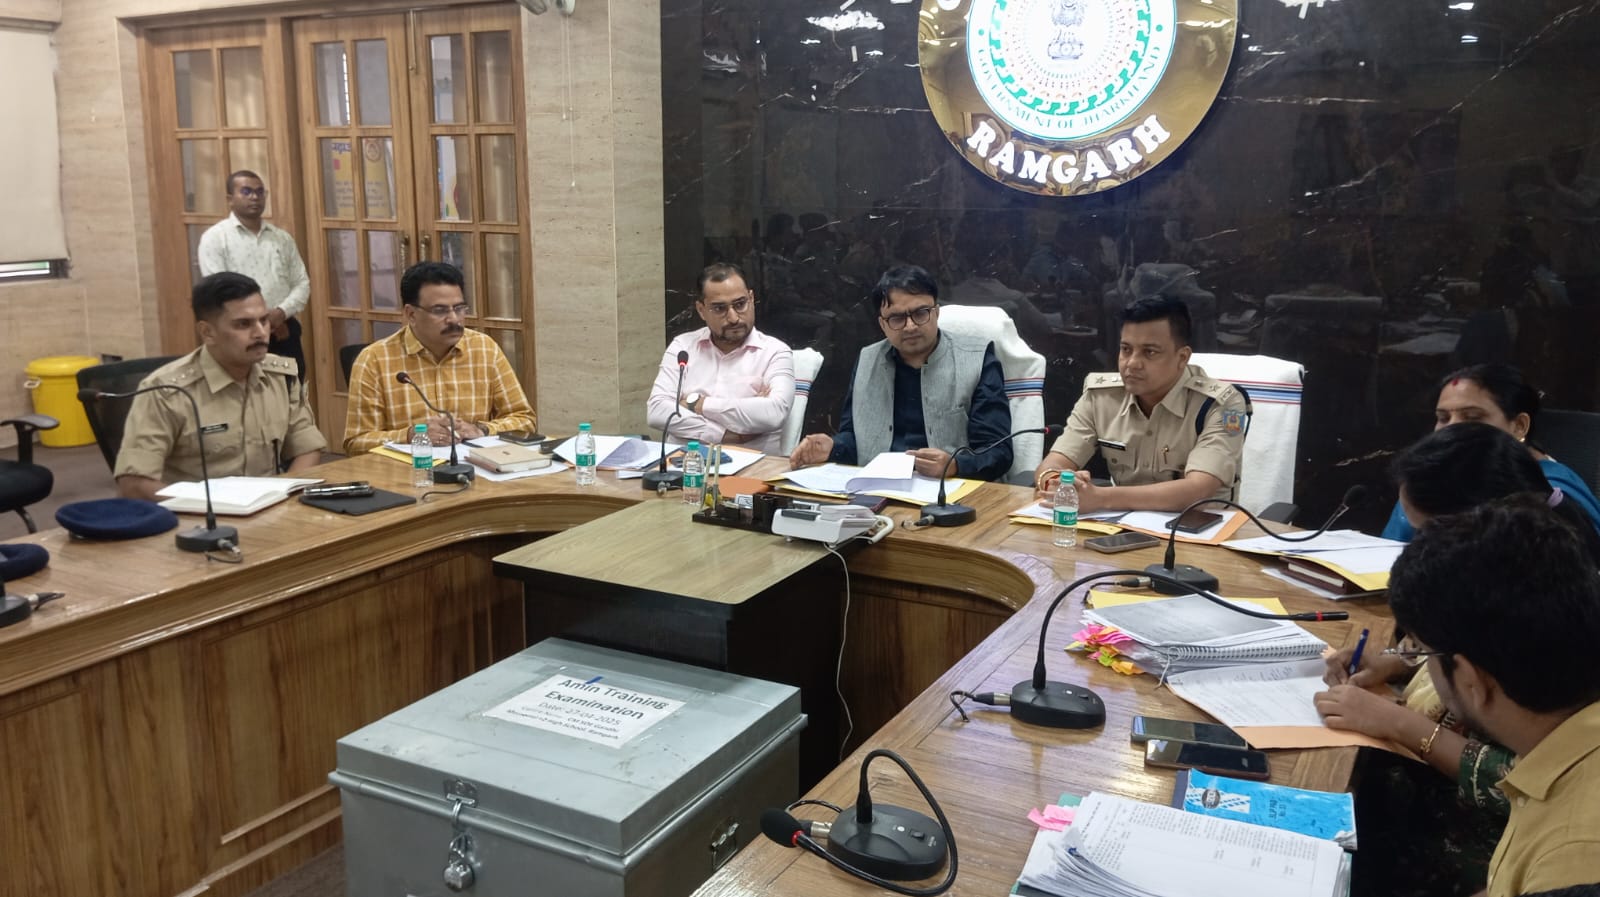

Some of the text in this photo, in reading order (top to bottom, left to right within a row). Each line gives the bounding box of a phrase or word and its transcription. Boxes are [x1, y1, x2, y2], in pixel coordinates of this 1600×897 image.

[1057, 119, 1074, 129] OF
[1083, 46, 1161, 126] JHARKHAND
[966, 114, 1171, 184] RAMGARH
[544, 690, 644, 720] Examination
[557, 679, 670, 711] Amin Training
